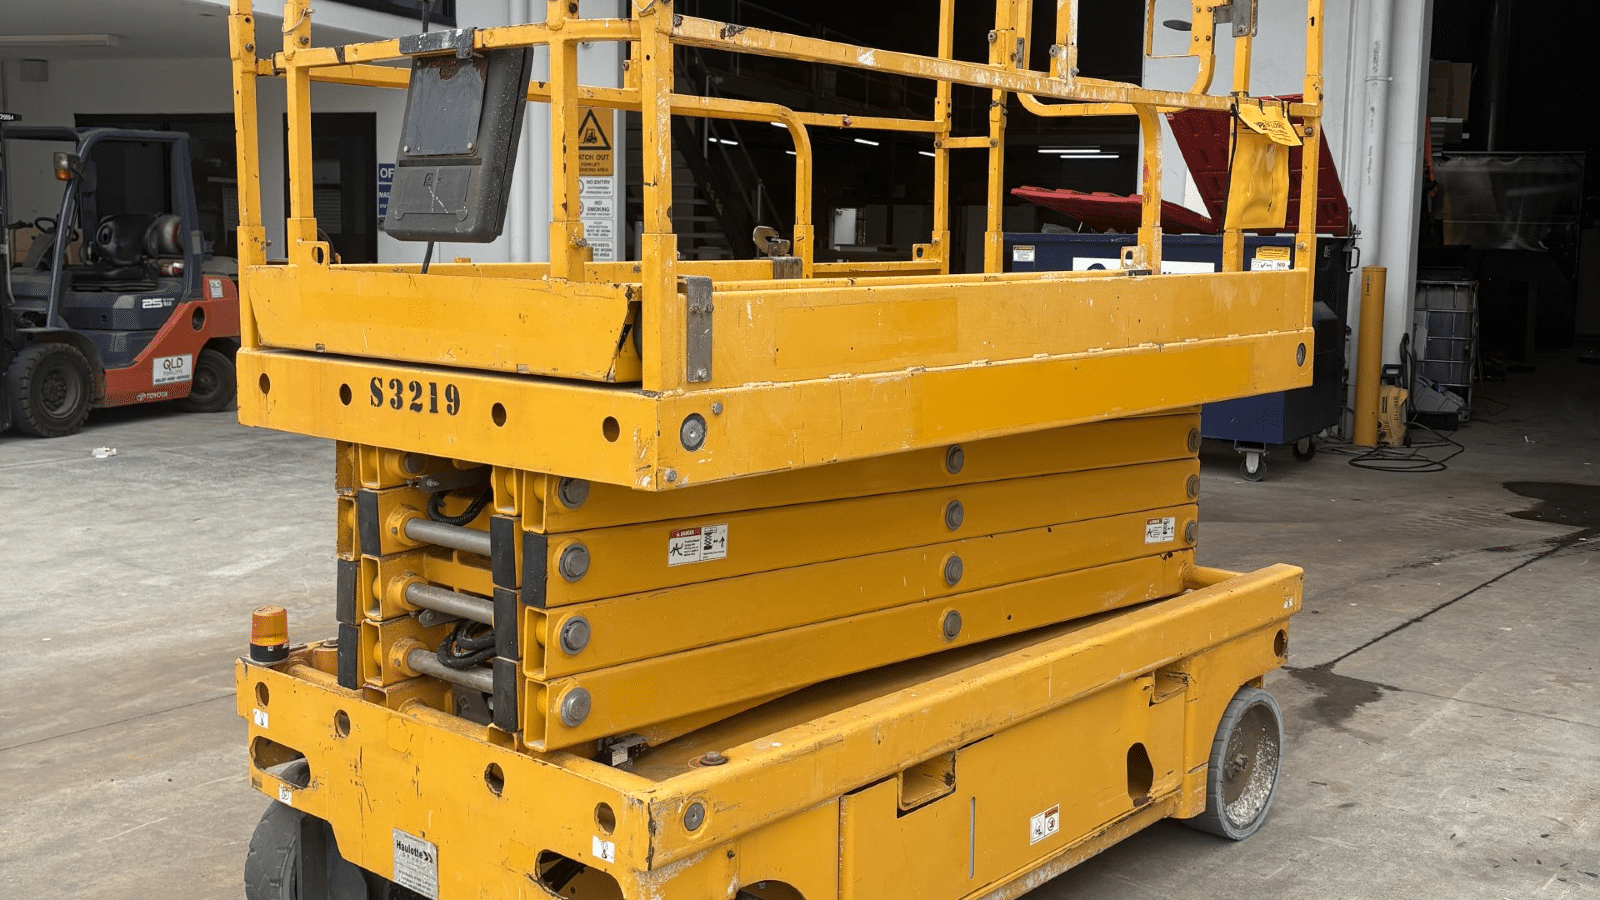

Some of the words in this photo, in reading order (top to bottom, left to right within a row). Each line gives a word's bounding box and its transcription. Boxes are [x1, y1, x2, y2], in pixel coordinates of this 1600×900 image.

[380, 168, 394, 178] OF
[142, 298, 163, 309] 25
[163, 357, 183, 371] QLD
[370, 377, 460, 416] S3219
[396, 840, 423, 859] Haulotte
